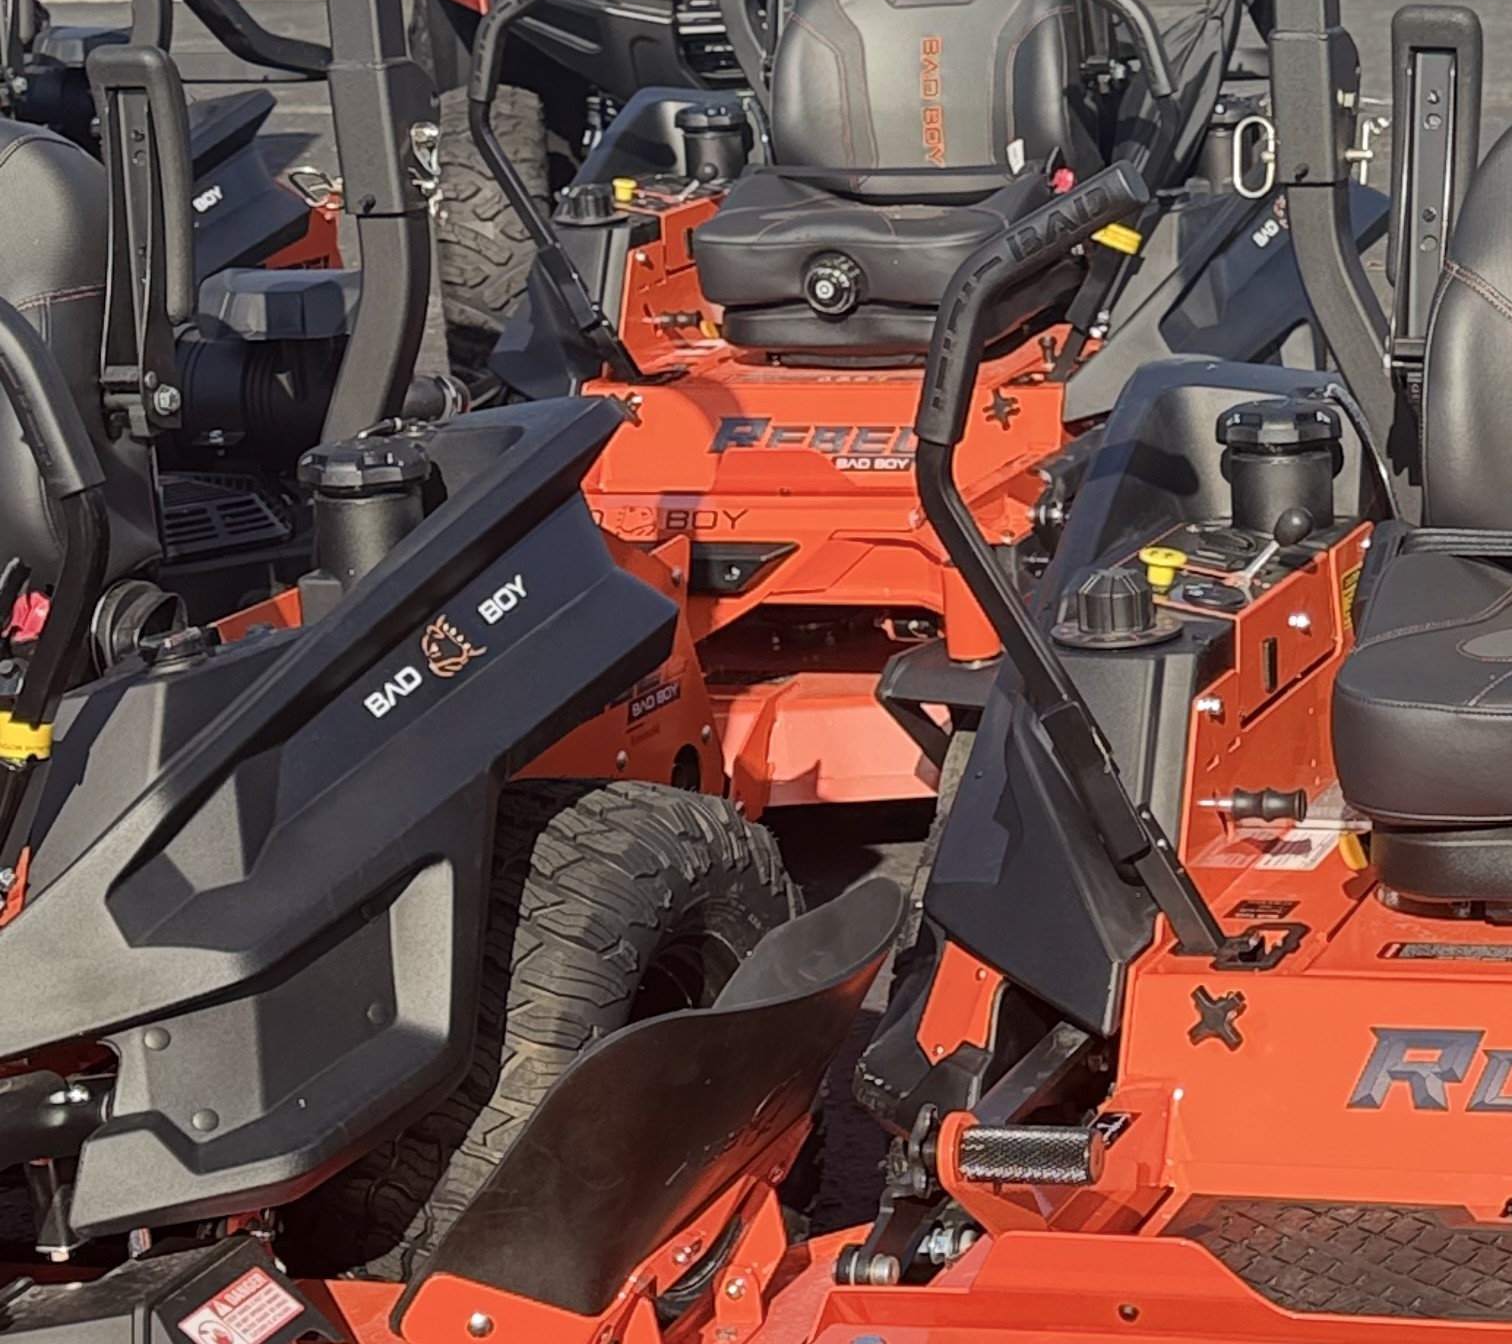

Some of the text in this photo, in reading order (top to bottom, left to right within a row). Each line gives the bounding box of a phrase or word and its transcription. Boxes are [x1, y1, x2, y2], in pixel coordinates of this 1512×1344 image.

[920, 36, 946, 168] BAD BOY
[1005, 186, 1111, 263] BAD
[835, 457, 910, 470] BAD BOY
[665, 508, 749, 531] BOY
[363, 573, 529, 719] BAD BOY
[632, 681, 679, 718] BAD BOY
